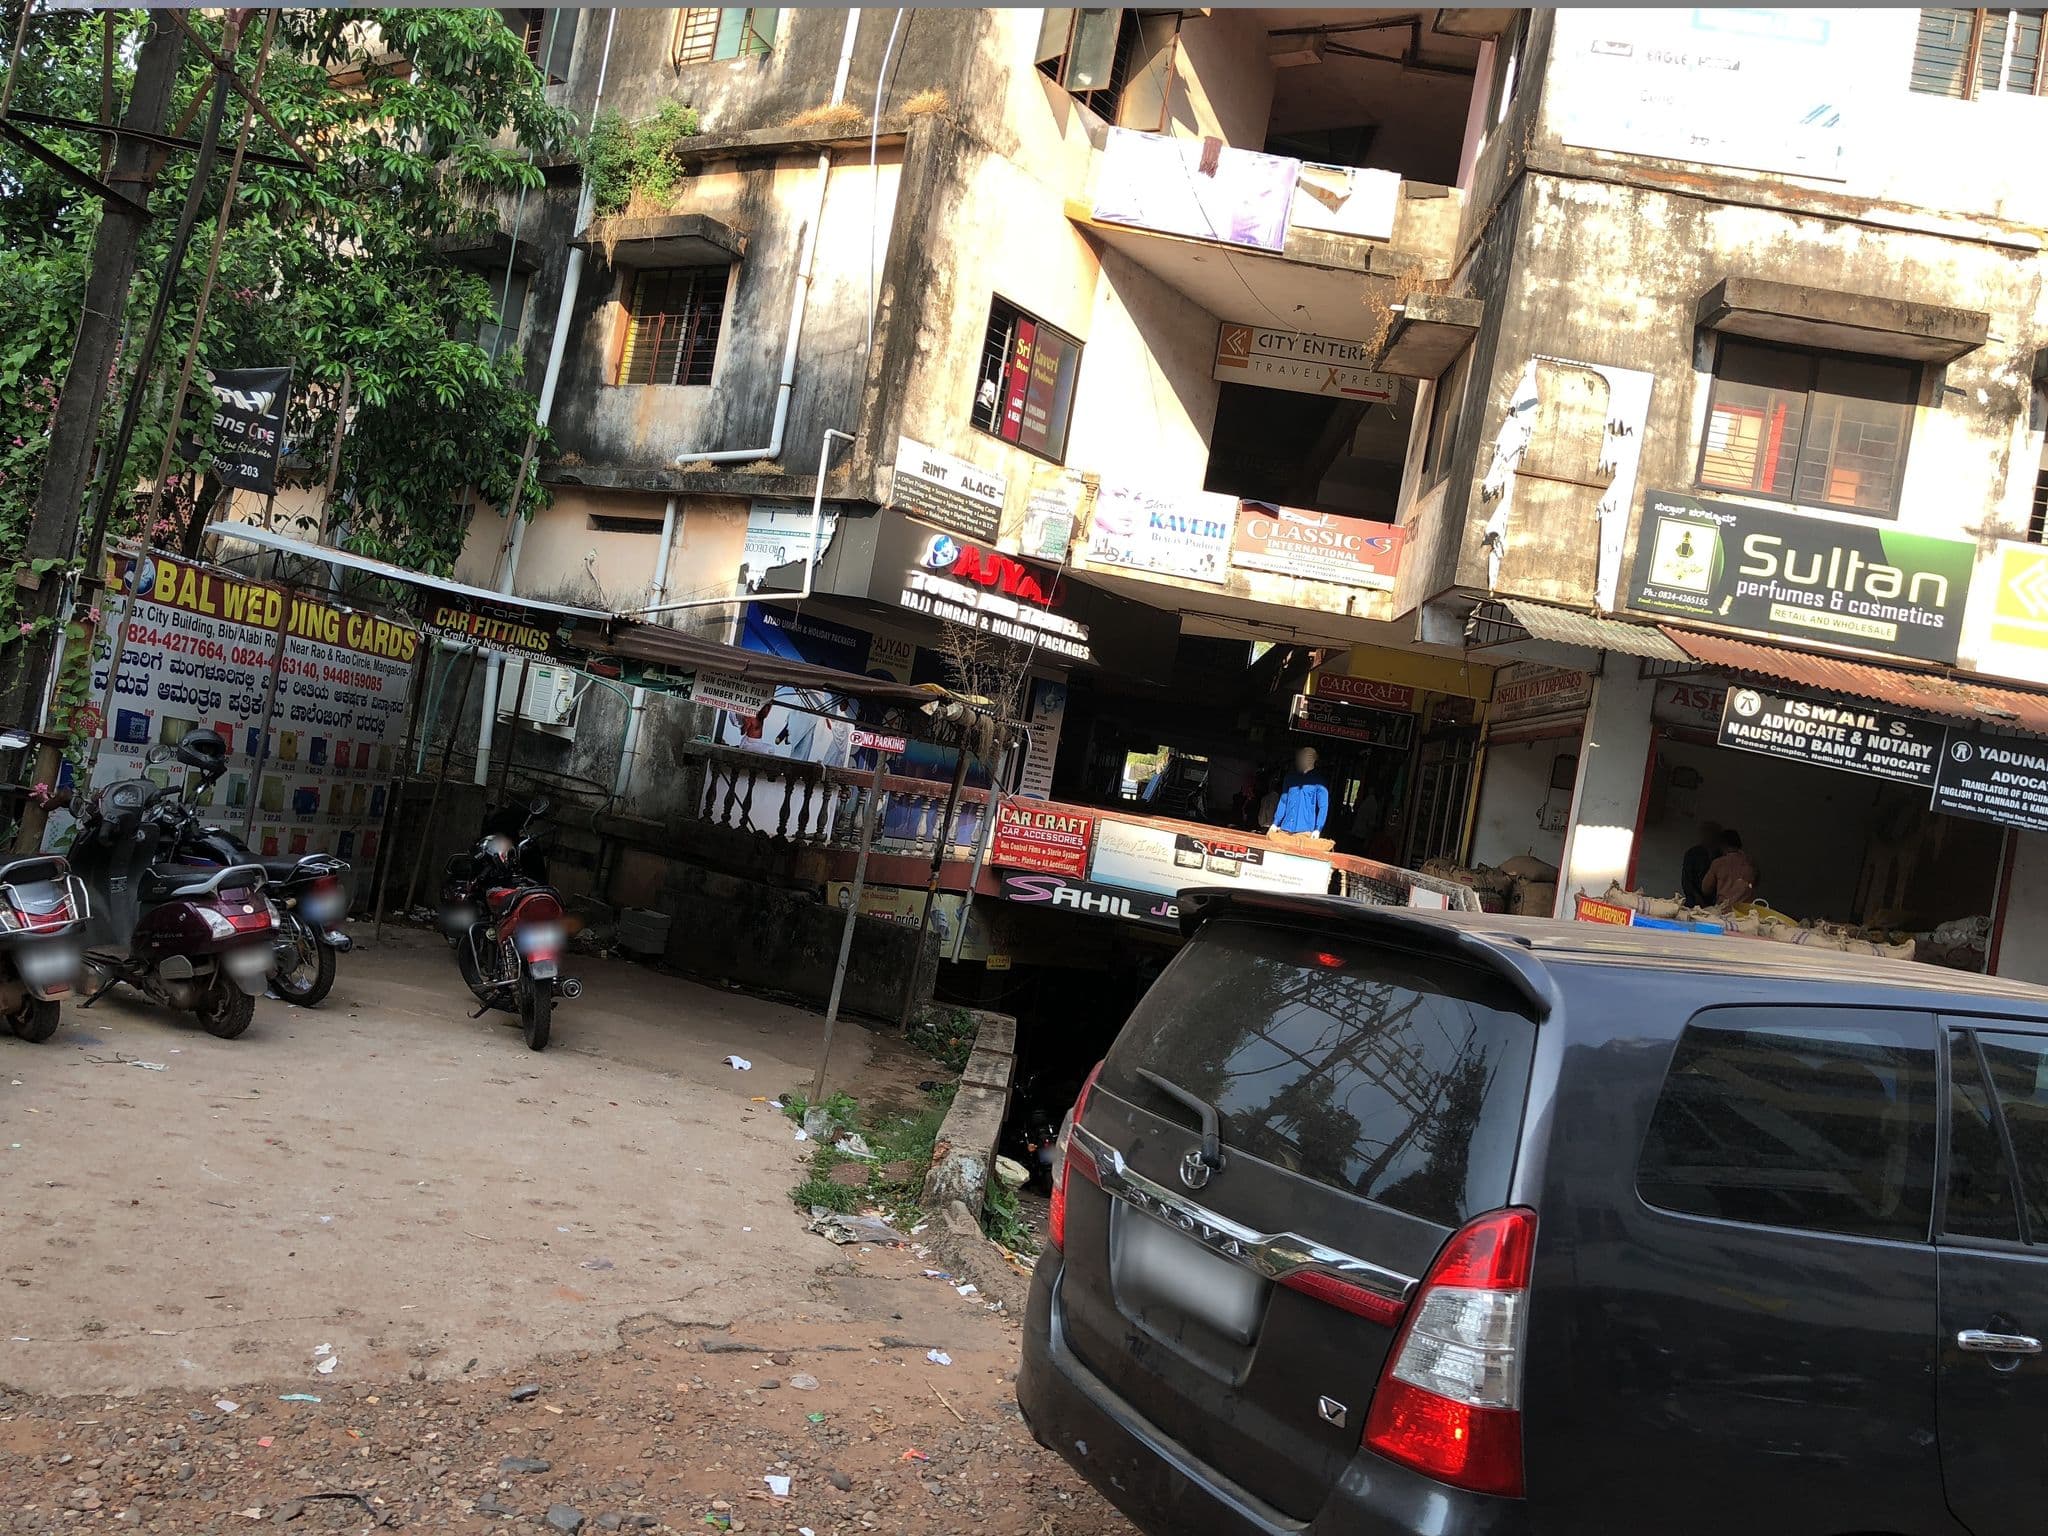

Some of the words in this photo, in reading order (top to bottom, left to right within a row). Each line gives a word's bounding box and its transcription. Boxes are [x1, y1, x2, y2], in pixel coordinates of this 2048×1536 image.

[1016, 338, 1032, 359] Sri
[1258, 334, 1298, 351] CITY
[1303, 339, 1369, 361] ENTERP
[209, 454, 233, 472] hop
[240, 464, 259, 478] 203
[1149, 511, 1227, 540] KAVERI
[1247, 519, 1362, 551] CLASSIC
[1267, 538, 1359, 561] INTERNATIONAL
[952, 544, 1047, 605] AJYA
[1739, 533, 1949, 608] Sultan
[1737, 579, 1825, 609] perfumes
[1829, 590, 1844, 610] &
[1848, 598, 1945, 628] cosmetics
[421, 621, 441, 636] New
[443, 628, 465, 642] Craft
[467, 634, 481, 647] For
[483, 638, 505, 652] New
[436, 607, 470, 630] CAR
[473, 616, 552, 651] FITTINGS
[900, 590, 931, 613] HAJJ
[933, 601, 978, 627] UMRAH
[980, 616, 989, 630] &
[992, 617, 1037, 644] HOLIDAY
[1038, 632, 1090, 660] PACKAGES
[1775, 609, 1808, 622] RETAIL
[1810, 614, 1831, 626] AND
[1833, 617, 1893, 637] WHOLESALE
[147, 605, 170, 628] City
[171, 612, 216, 638] Building,
[218, 624, 238, 640] Bibi
[238, 627, 263, 645] Alabi
[265, 634, 287, 653] Ro,
[290, 640, 309, 656] Near
[311, 644, 326, 660] Rao
[327, 651, 334, 660] &
[335, 650, 351, 665] Rao
[352, 654, 372, 670] Circle,
[347, 614, 416, 661] CARDS
[231, 646, 320, 682] 0824-463140,
[323, 666, 382, 691] 9448159085
[701, 674, 715, 684] SUN
[717, 678, 749, 693] CONTROL
[750, 686, 769, 697] FILM
[703, 686, 733, 699] NUMBER
[734, 694, 762, 706] PLATES
[1785, 699, 1879, 732] ISMAIL
[1890, 721, 1915, 739] S.
[862, 734, 873, 747] NO
[873, 735, 905, 752] PARKING
[1727, 722, 1806, 749] NAUSHAD
[1811, 740, 1858, 760] BANU
[1863, 752, 1932, 775] ADVOCATE
[1760, 712, 1845, 743] ADVOCATE
[1850, 731, 1863, 746] &
[1867, 735, 1934, 760] NOTARY
[1872, 765, 1919, 780] Mangalore
[1978, 746, 2048, 772] YADUNA
[1961, 779, 2009, 796] TRANSLATOR
[2010, 790, 2021, 798] OF
[1991, 770, 2048, 791] ADVOCA
[1939, 786, 1971, 800] ENGLISH
[1974, 793, 1983, 801] TO
[1985, 795, 2020, 809] KANNADA
[2022, 802, 2028, 811] &
[1000, 808, 1031, 826] CAR
[1036, 814, 1088, 835] CRAFT
[1002, 826, 1020, 835] CAR
[1023, 830, 1083, 846] ACCESSORIES
[1010, 842, 1028, 852] Control
[1028, 846, 1041, 854] Films
[1062, 850, 1080, 860] System
[1006, 876, 1141, 920] SAHIL
